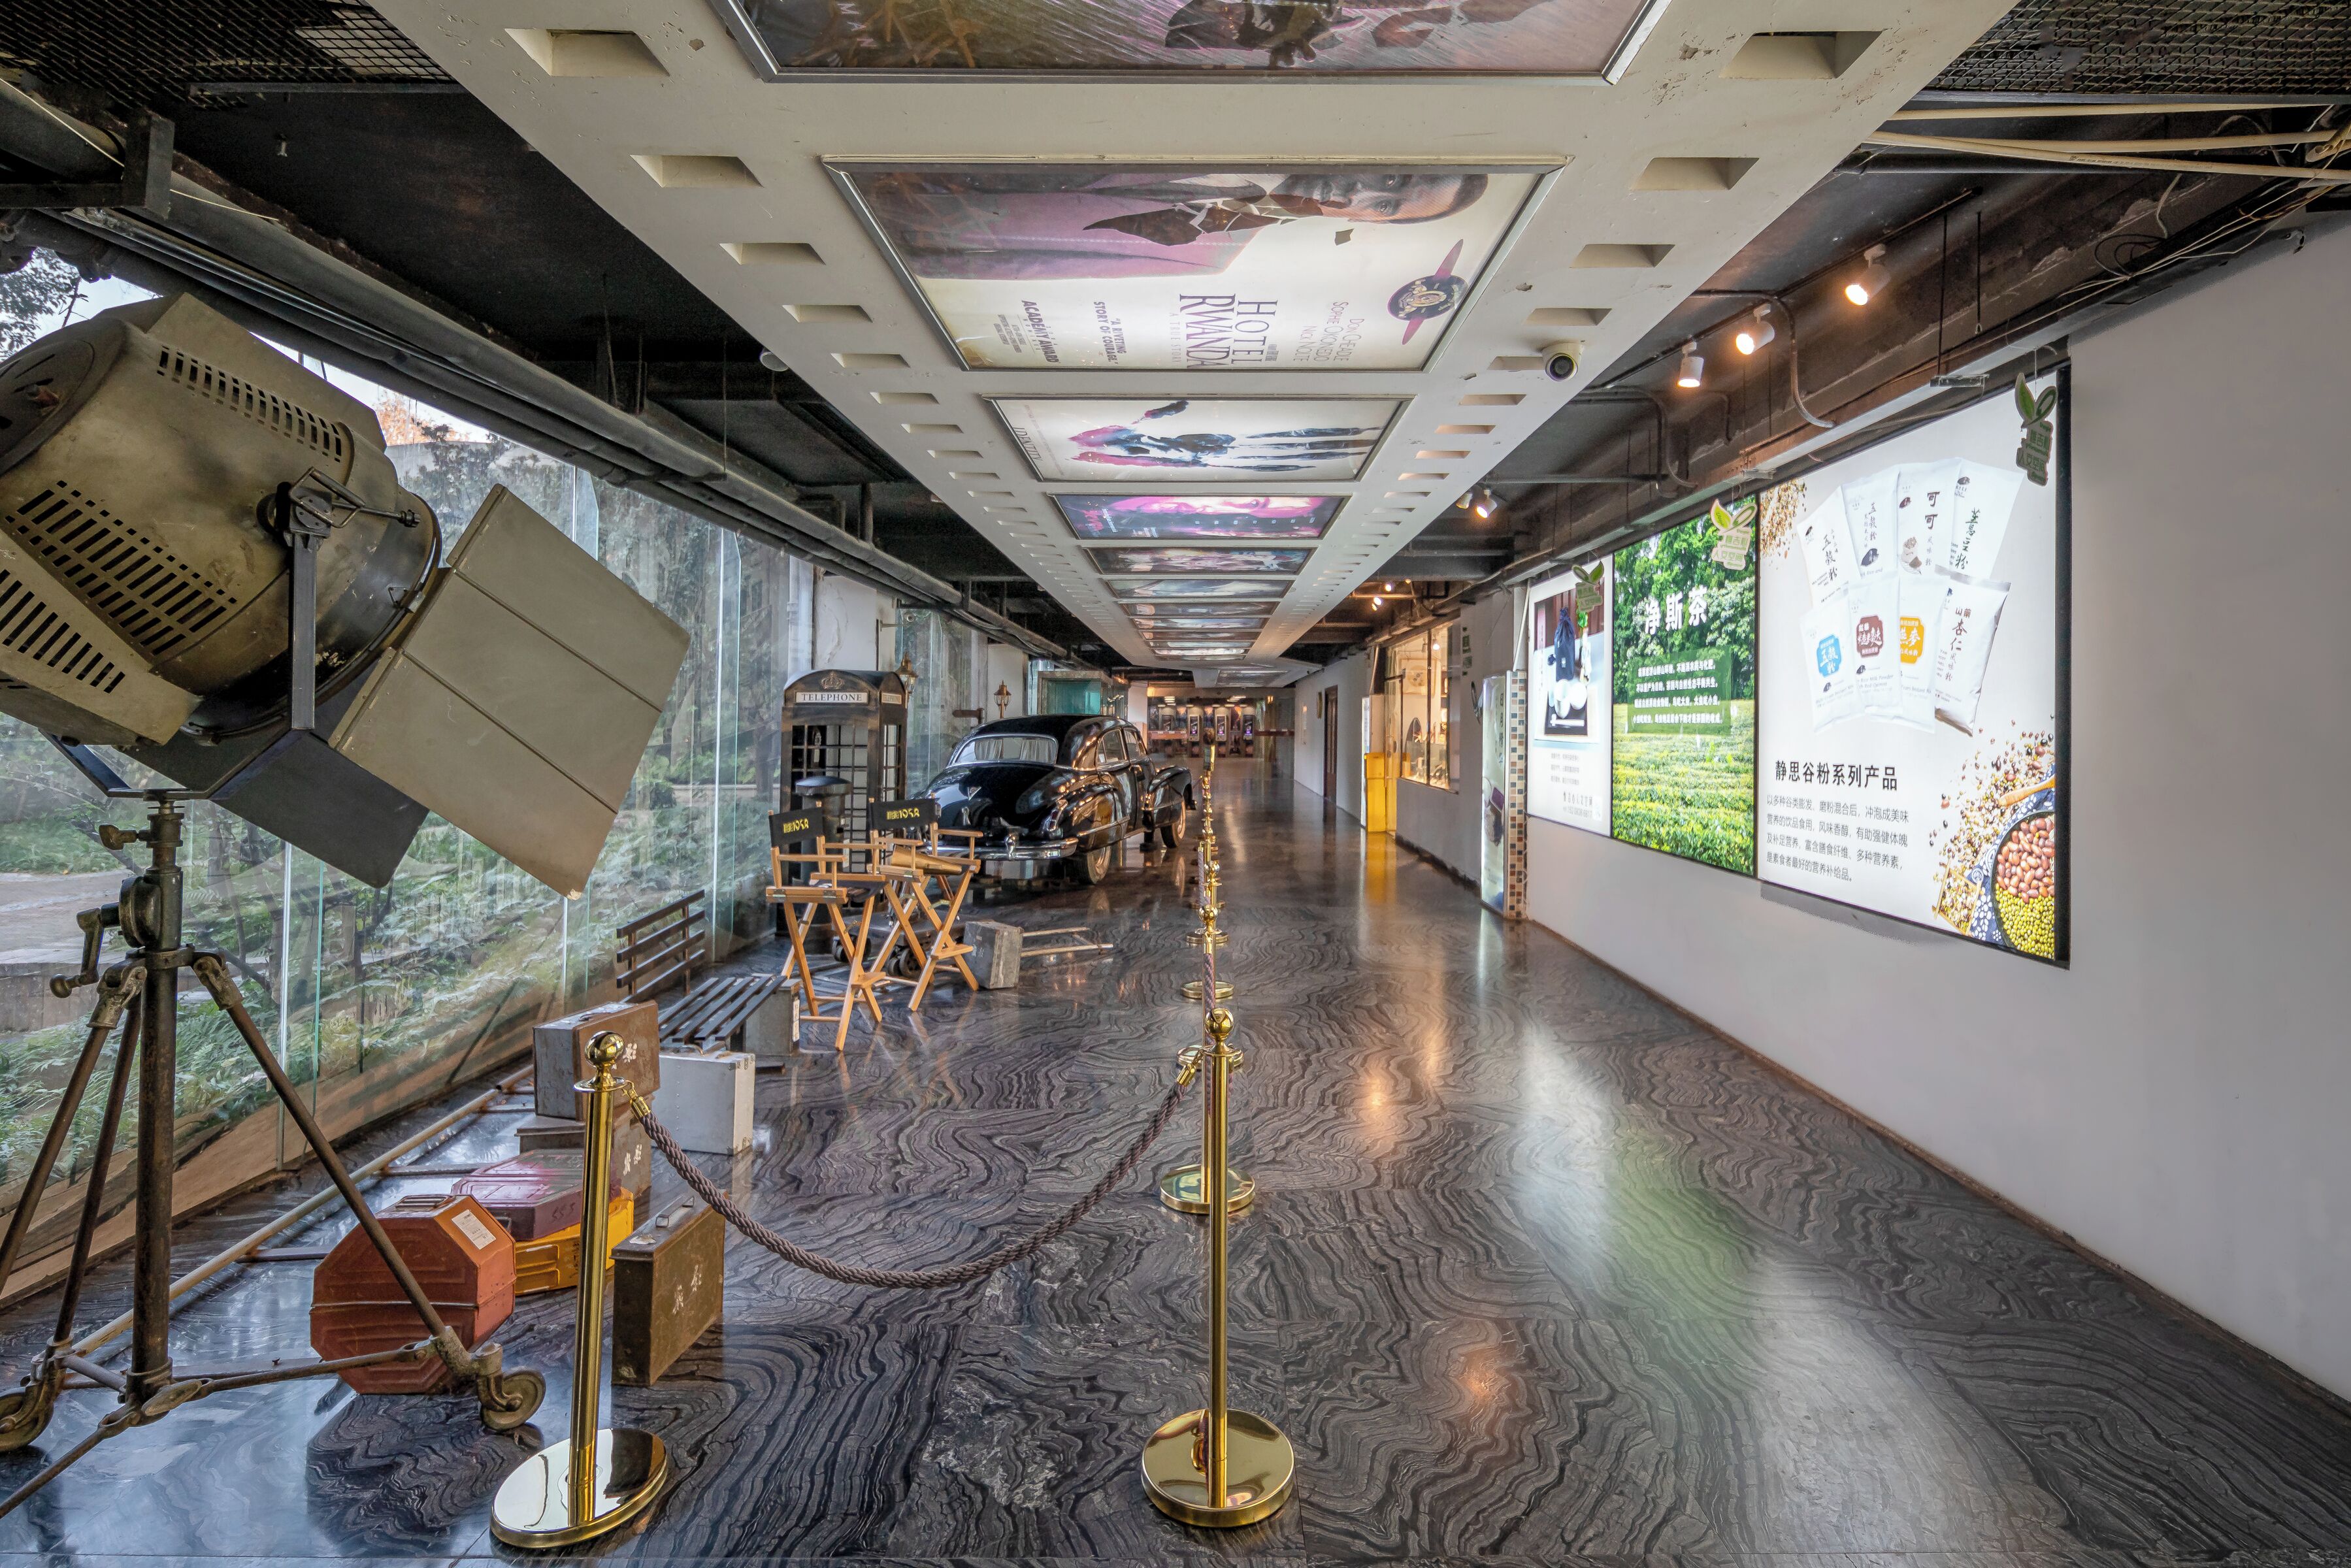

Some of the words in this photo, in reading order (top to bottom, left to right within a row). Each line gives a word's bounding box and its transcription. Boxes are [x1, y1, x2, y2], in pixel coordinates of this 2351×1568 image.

[1021, 301, 1050, 339] ACADEMY
[1094, 301, 1108, 323] STORY
[1099, 326, 1111, 335] OF
[1111, 328, 1126, 354] RIVETING
[1170, 322, 1181, 340] TRUE
[1179, 293, 1236, 368] RWANDA
[1231, 300, 1277, 364] HOTEL
[1314, 326, 1343, 362] OKONEDO
[1171, 344, 1182, 363] STORY
[1293, 342, 1314, 361] NOLTE
[1924, 491, 1940, 530] 可可
[1645, 585, 1709, 636] 净斯茶
[1950, 619, 1967, 651] 杏仁
[1775, 760, 1898, 791] 静思谷粉系列产品
[1767, 851, 1852, 882] 是素食者最好的营养补给品。
